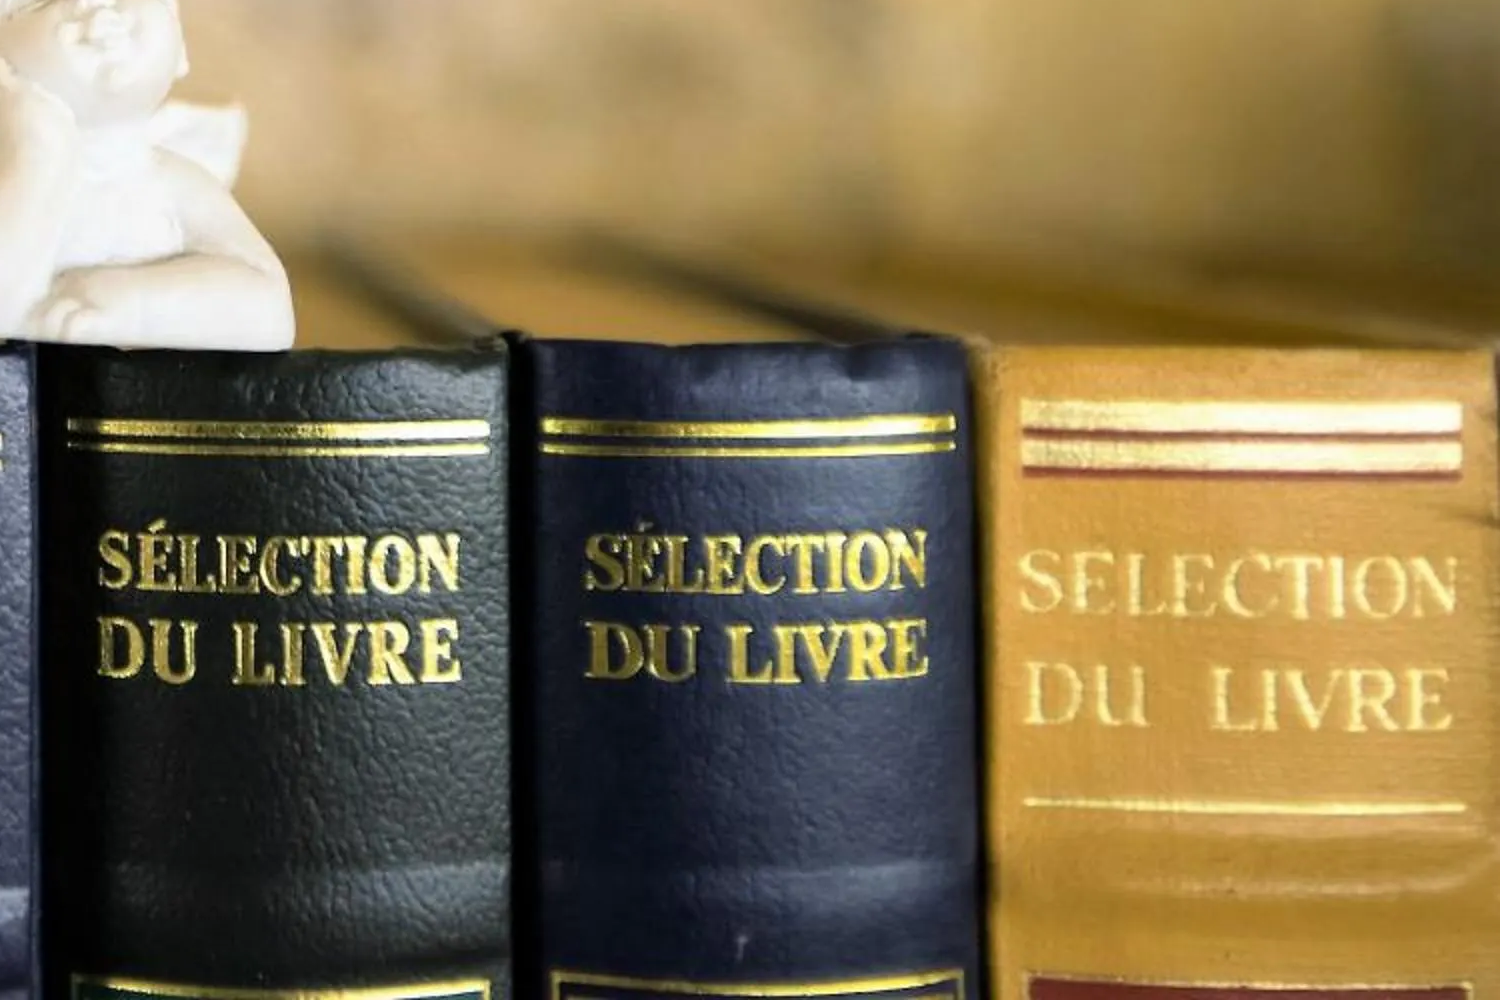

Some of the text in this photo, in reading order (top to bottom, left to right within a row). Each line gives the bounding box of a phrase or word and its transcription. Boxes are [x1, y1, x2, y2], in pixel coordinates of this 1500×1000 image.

[98, 518, 461, 596] SÉLECTION
[585, 521, 928, 595] SÉLECTION
[97, 616, 462, 685] DU LIVRE
[584, 618, 929, 685] DU LIVRE
[1023, 661, 1453, 732] DU LIVRE
